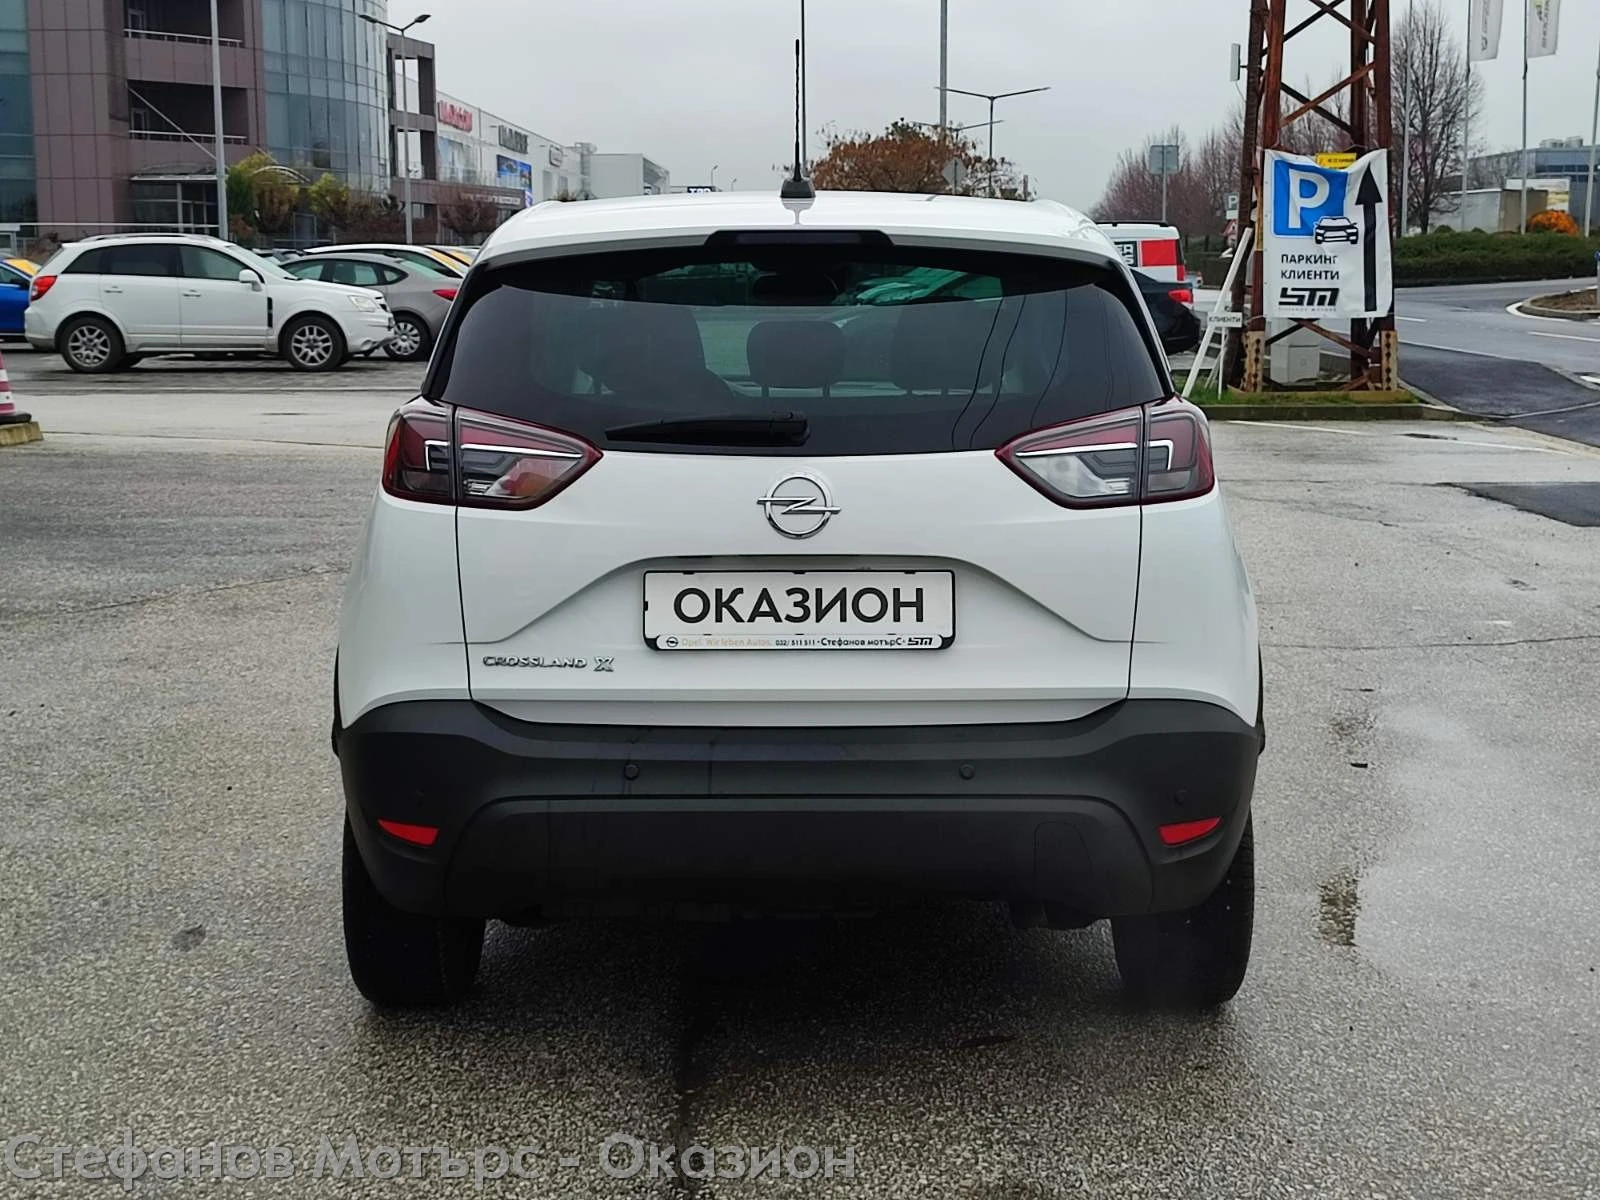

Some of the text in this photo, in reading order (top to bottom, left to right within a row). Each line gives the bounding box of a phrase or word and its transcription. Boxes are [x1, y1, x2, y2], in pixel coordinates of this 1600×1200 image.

[1288, 168, 1330, 229] P
[1280, 254, 1338, 265] ПАРКИНГ
[1280, 269, 1340, 281] КЛИЕНТИ
[673, 586, 924, 623] ОКАЗИОН
[482, 656, 615, 673] CROSSLAND X
